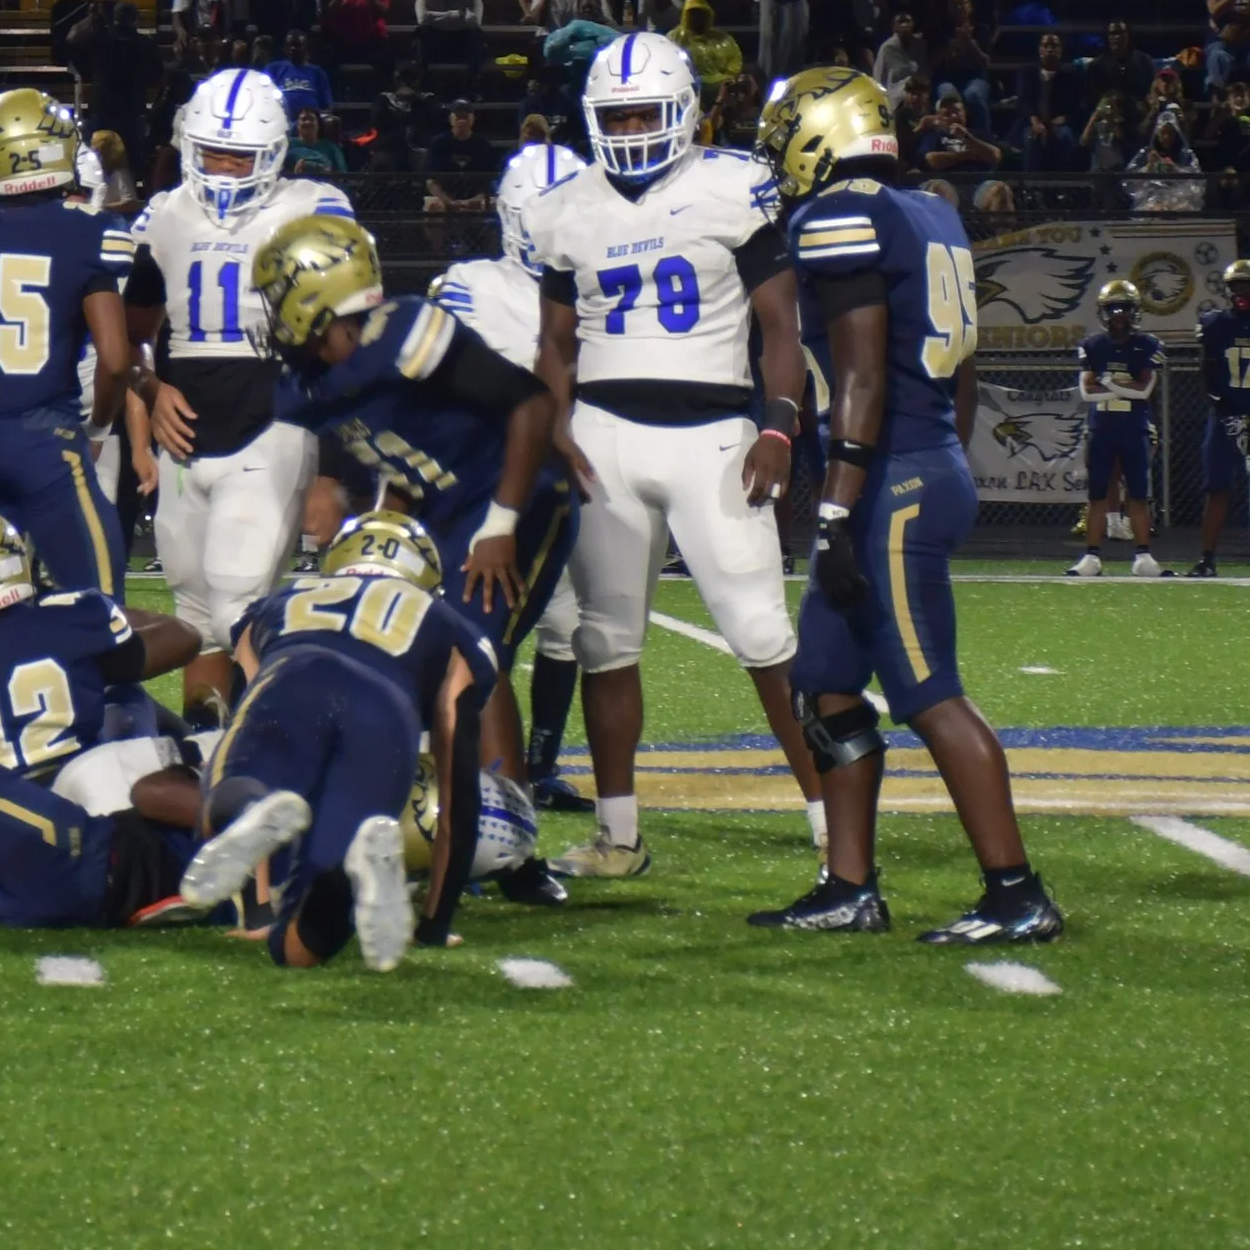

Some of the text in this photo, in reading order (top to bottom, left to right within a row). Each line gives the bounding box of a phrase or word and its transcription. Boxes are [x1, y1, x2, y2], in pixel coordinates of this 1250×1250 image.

[4, 175, 56, 194] Riddell
[606, 237, 665, 258] BLUE DEVILS
[187, 260, 244, 343] 11
[596, 255, 701, 335] 78
[921, 241, 978, 379] 95
[977, 325, 1086, 348] ENIORS
[890, 477, 924, 496] PAXON
[279, 575, 434, 658] 20
